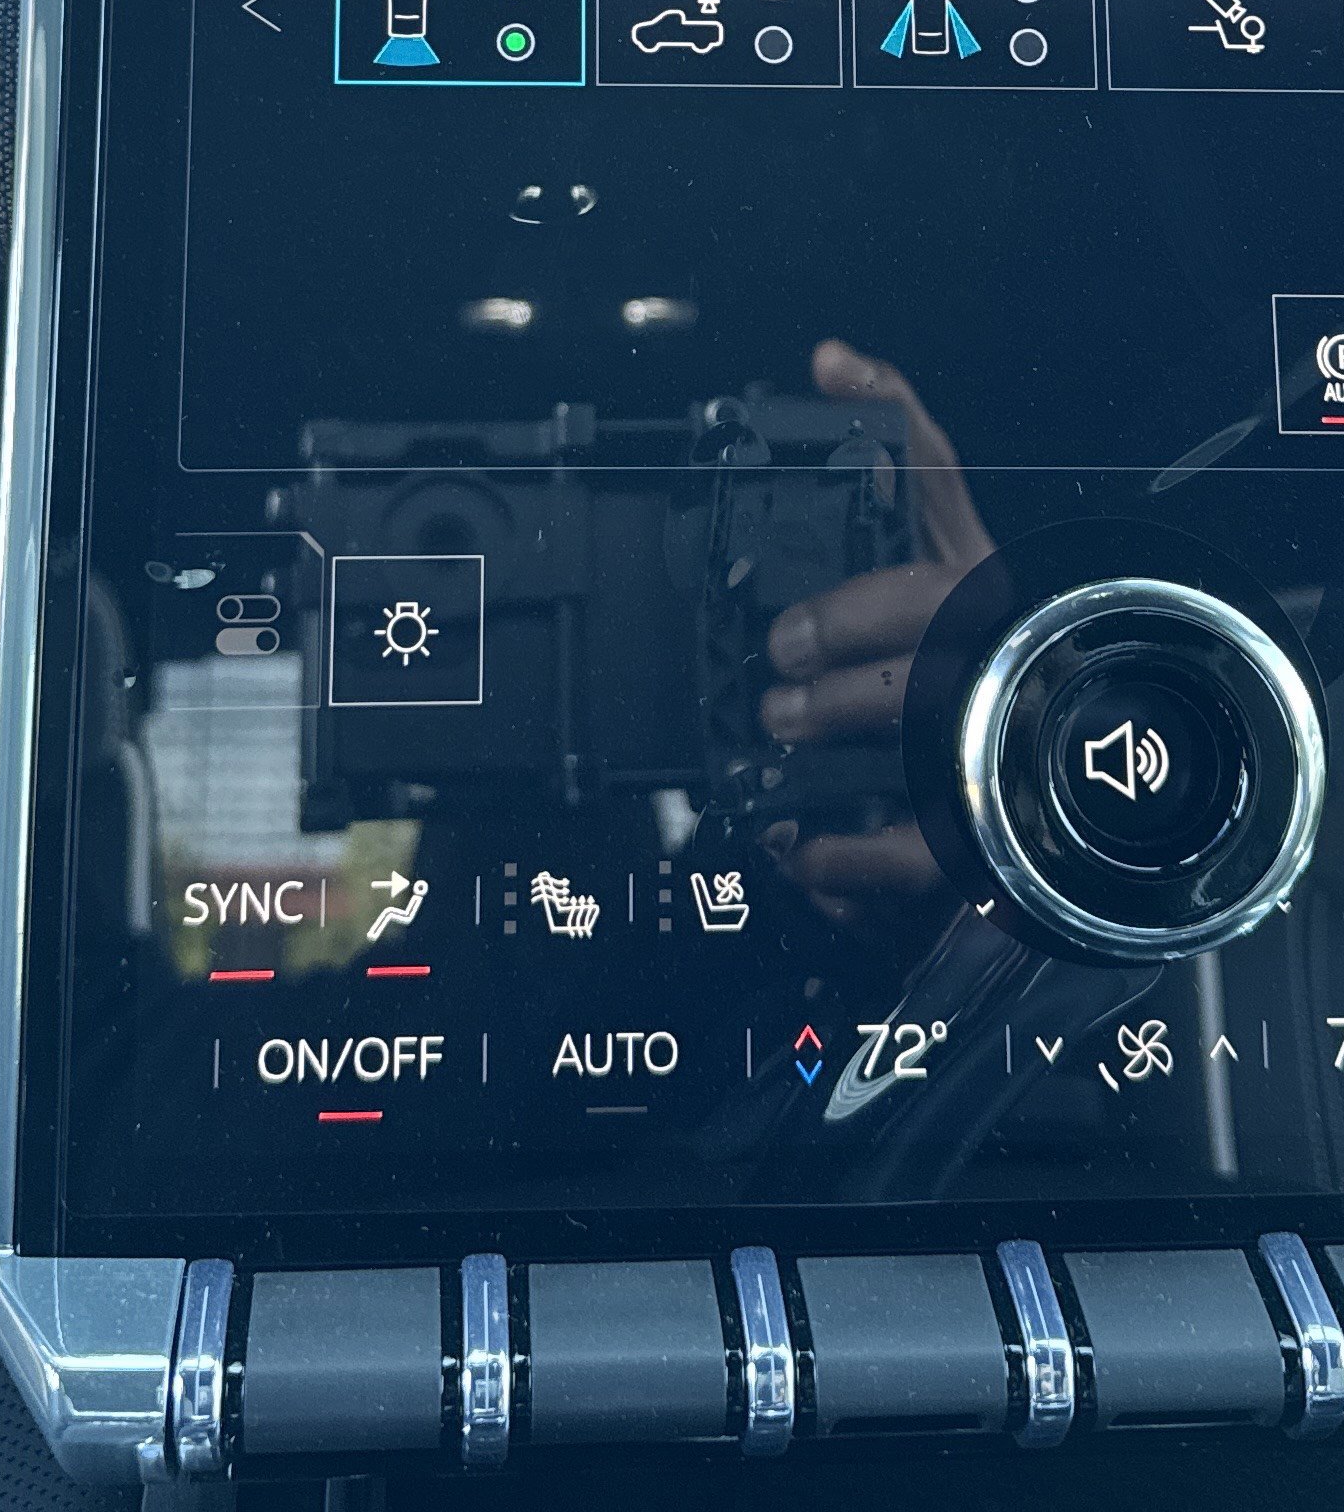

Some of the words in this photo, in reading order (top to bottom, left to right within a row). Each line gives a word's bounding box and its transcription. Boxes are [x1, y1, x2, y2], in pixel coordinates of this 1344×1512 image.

[183, 880, 305, 926] SYNC
[257, 1035, 445, 1084] ON/OFF
[552, 1031, 678, 1078] AUTO
[856, 1020, 948, 1078] 72°
